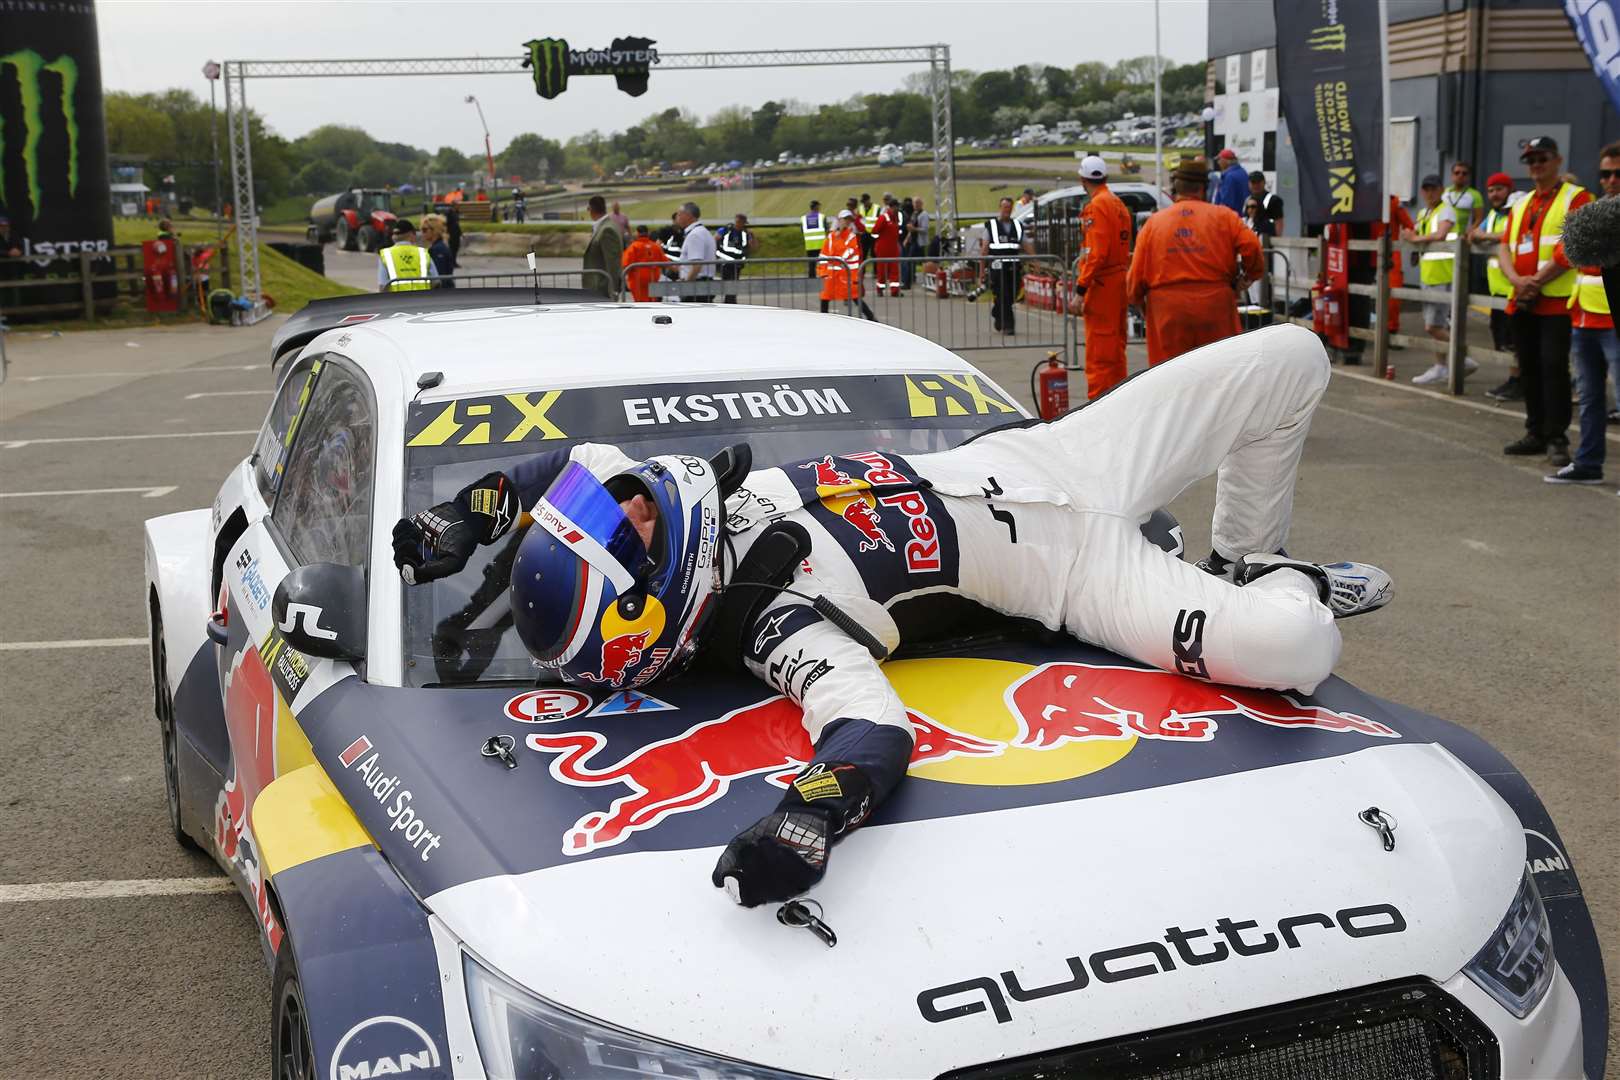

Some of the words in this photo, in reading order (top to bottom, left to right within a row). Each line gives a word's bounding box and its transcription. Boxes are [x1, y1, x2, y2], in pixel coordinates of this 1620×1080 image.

[569, 50, 659, 66] MONSTER
[622, 384, 852, 426] EKSTRÖM
[838, 450, 913, 486] Bull
[542, 509, 567, 533] Audi
[697, 507, 711, 569] GoPro
[878, 490, 941, 574] Red
[680, 552, 695, 595] SCHUBERTH
[533, 713, 566, 722] EKS
[536, 696, 562, 714] E
[356, 752, 401, 805] Audi
[386, 790, 441, 862] Sport
[916, 903, 1408, 1025] quattro
[339, 1050, 431, 1080] MAN
